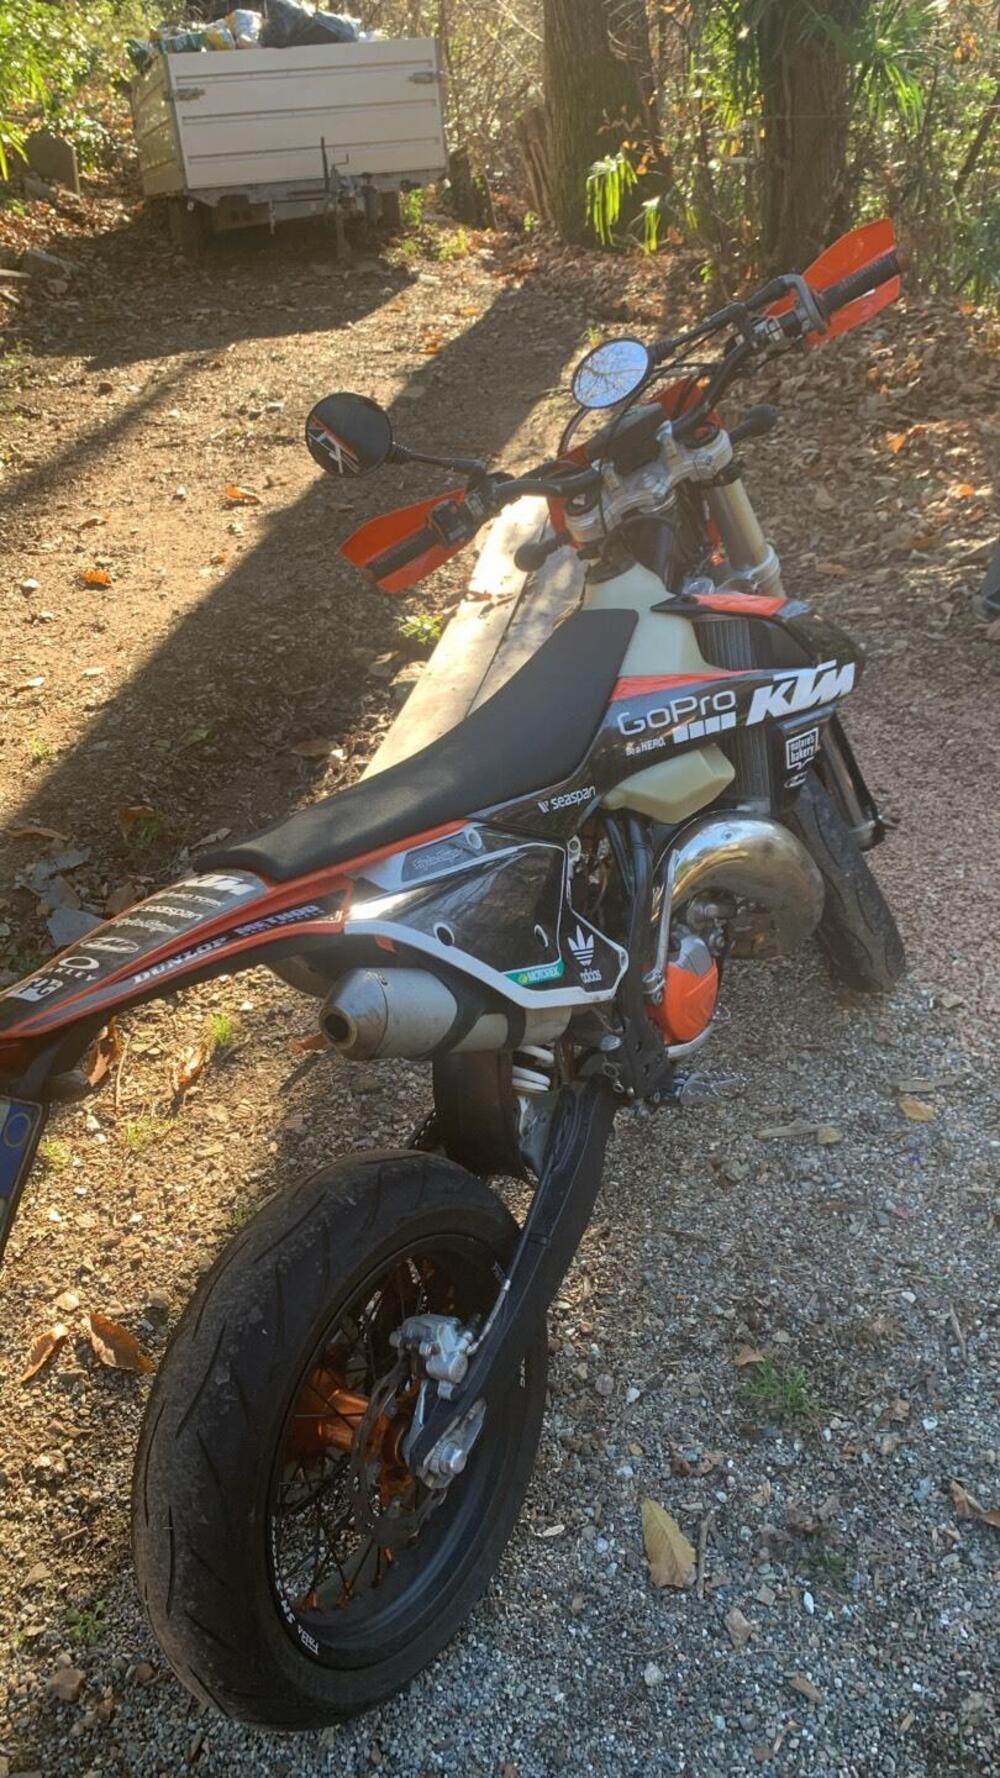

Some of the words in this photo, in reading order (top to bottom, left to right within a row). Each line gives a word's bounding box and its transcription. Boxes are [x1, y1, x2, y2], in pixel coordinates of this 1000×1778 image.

[617, 690, 737, 736] GoPro
[746, 659, 856, 726] KTM
[550, 785, 596, 810] seaspan
[133, 937, 228, 985] DUNLOP
[579, 968, 603, 984] adidas
